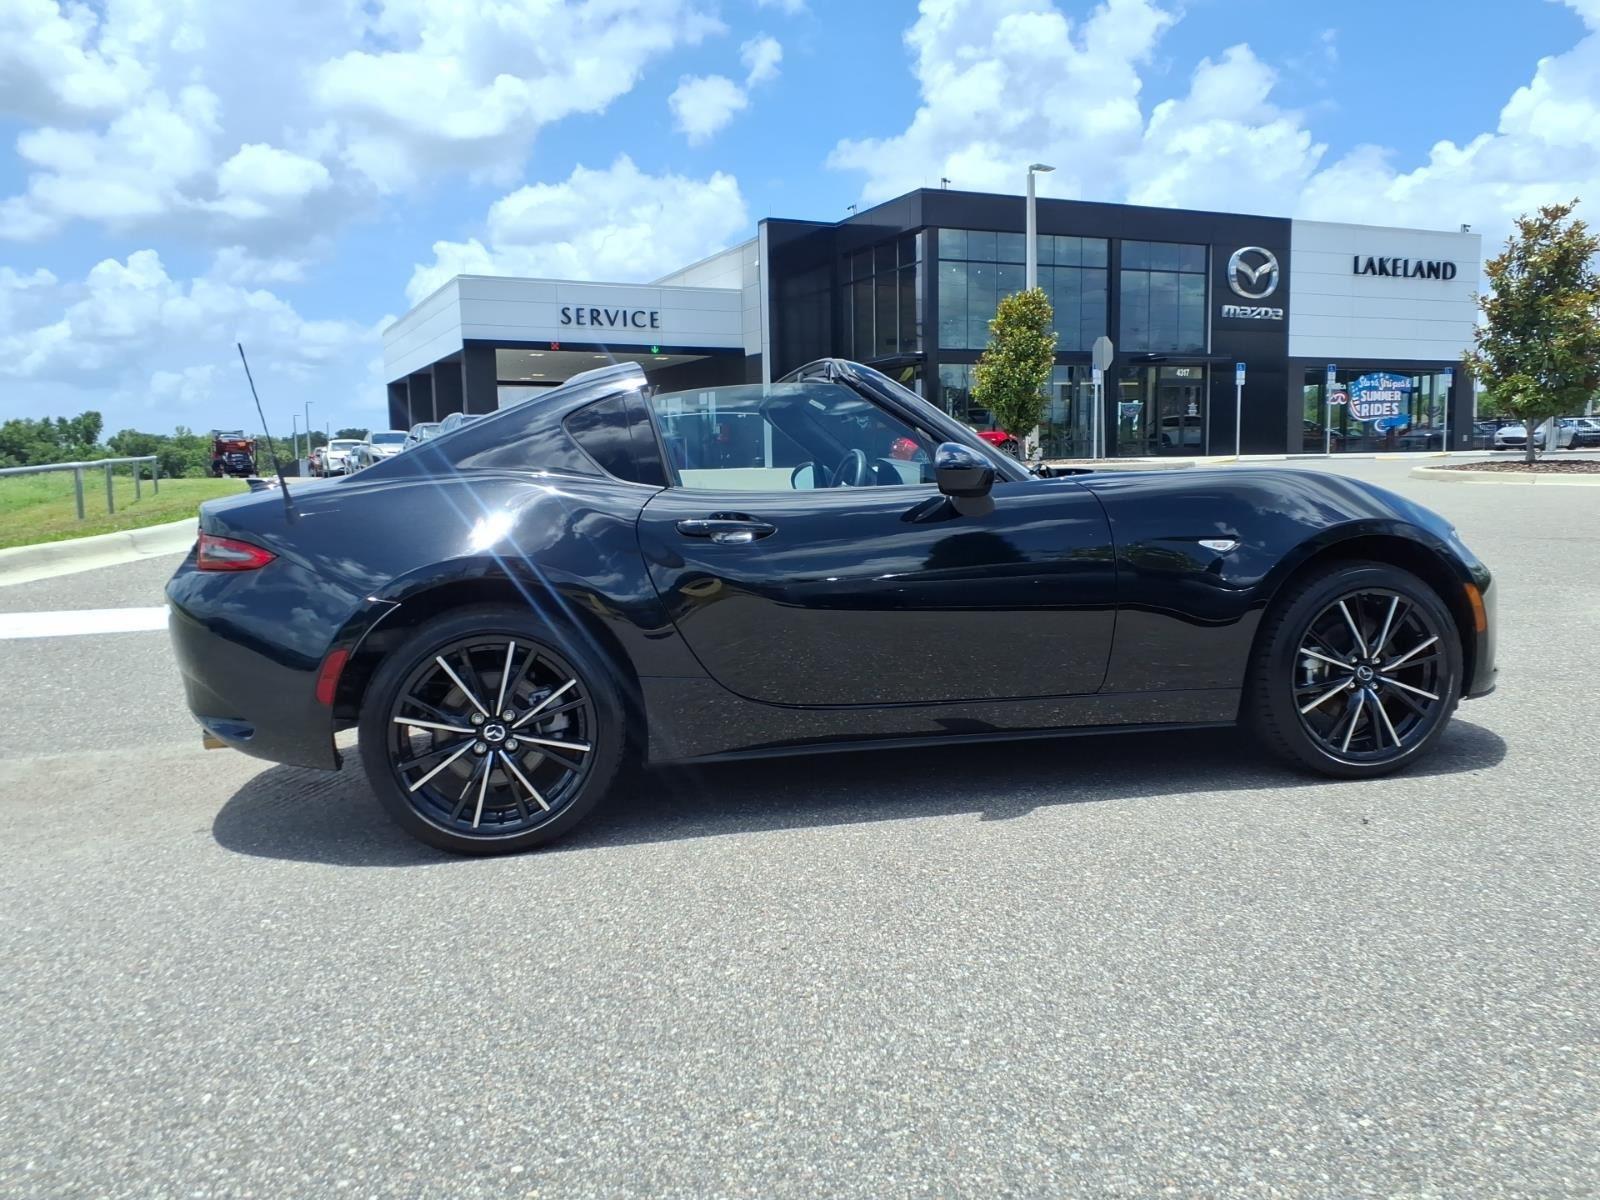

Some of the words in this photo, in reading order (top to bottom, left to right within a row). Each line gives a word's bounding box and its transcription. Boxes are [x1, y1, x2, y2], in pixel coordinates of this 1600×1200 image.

[1353, 255, 1457, 280] LAKELAND
[560, 307, 660, 329] SERVICE
[1360, 390, 1401, 401] SUMMER
[1361, 402, 1399, 416] RIDES
